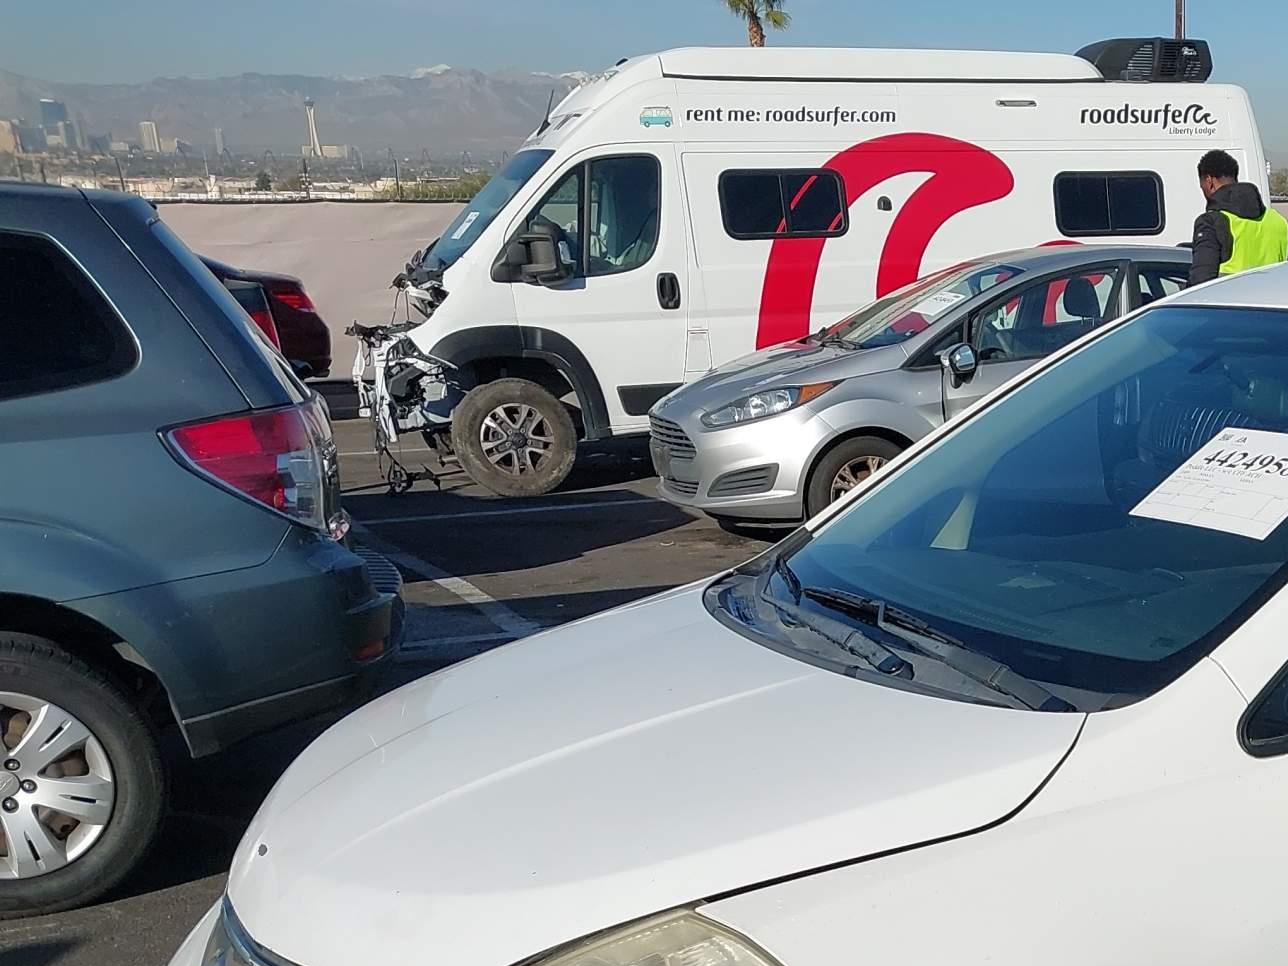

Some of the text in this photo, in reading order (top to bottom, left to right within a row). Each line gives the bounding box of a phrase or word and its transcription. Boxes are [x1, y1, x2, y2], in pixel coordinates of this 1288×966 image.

[686, 106, 897, 127] rent me: roadsurfer.com
[1169, 127, 1217, 136] Liberty Lodge
